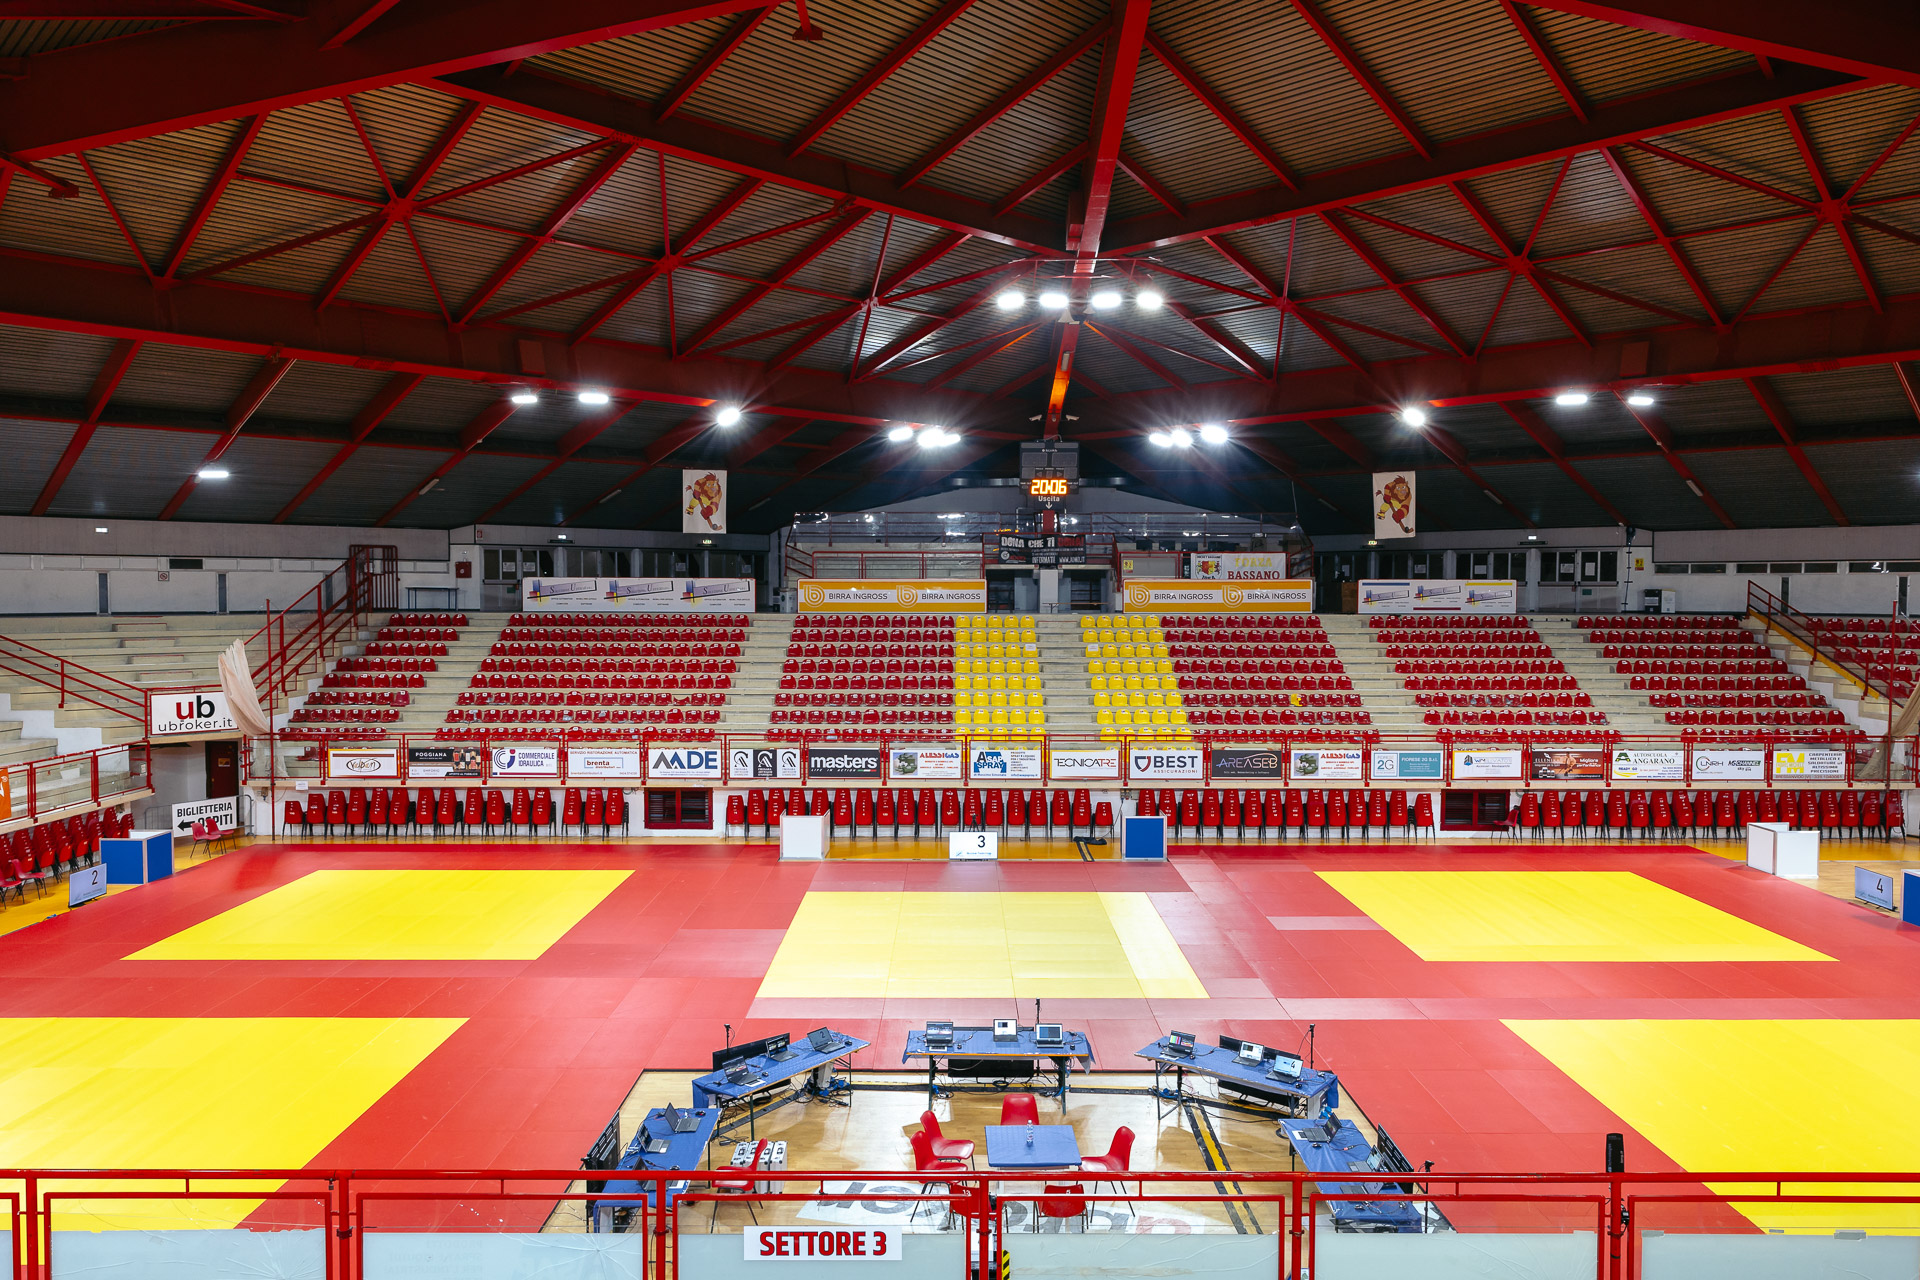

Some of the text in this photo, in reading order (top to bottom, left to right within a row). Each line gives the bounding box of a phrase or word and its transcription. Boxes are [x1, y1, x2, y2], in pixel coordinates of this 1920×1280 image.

[1001, 536, 1025, 548] DONA
[1028, 538, 1044, 548] CHE
[1234, 557, 1273, 568] FORZA
[1227, 570, 1280, 580] BASSANO
[1247, 592, 1307, 600] BIRRA INGROSS
[176, 695, 215, 720] ub
[158, 717, 233, 732] ubroker.it
[518, 752, 555, 760] COMMERCIALE
[810, 754, 877, 769] masters
[1153, 755, 1198, 768] BEST
[1776, 752, 1805, 774] FM
[1377, 759, 1394, 770] 2G
[176, 802, 233, 818] BIGLIETTERIA
[977, 834, 986, 848] 3
[91, 869, 98, 886] 2
[1876, 878, 1884, 894] 4
[819, 1030, 826, 1039] 2
[759, 1231, 887, 1257] SETTORE 3
